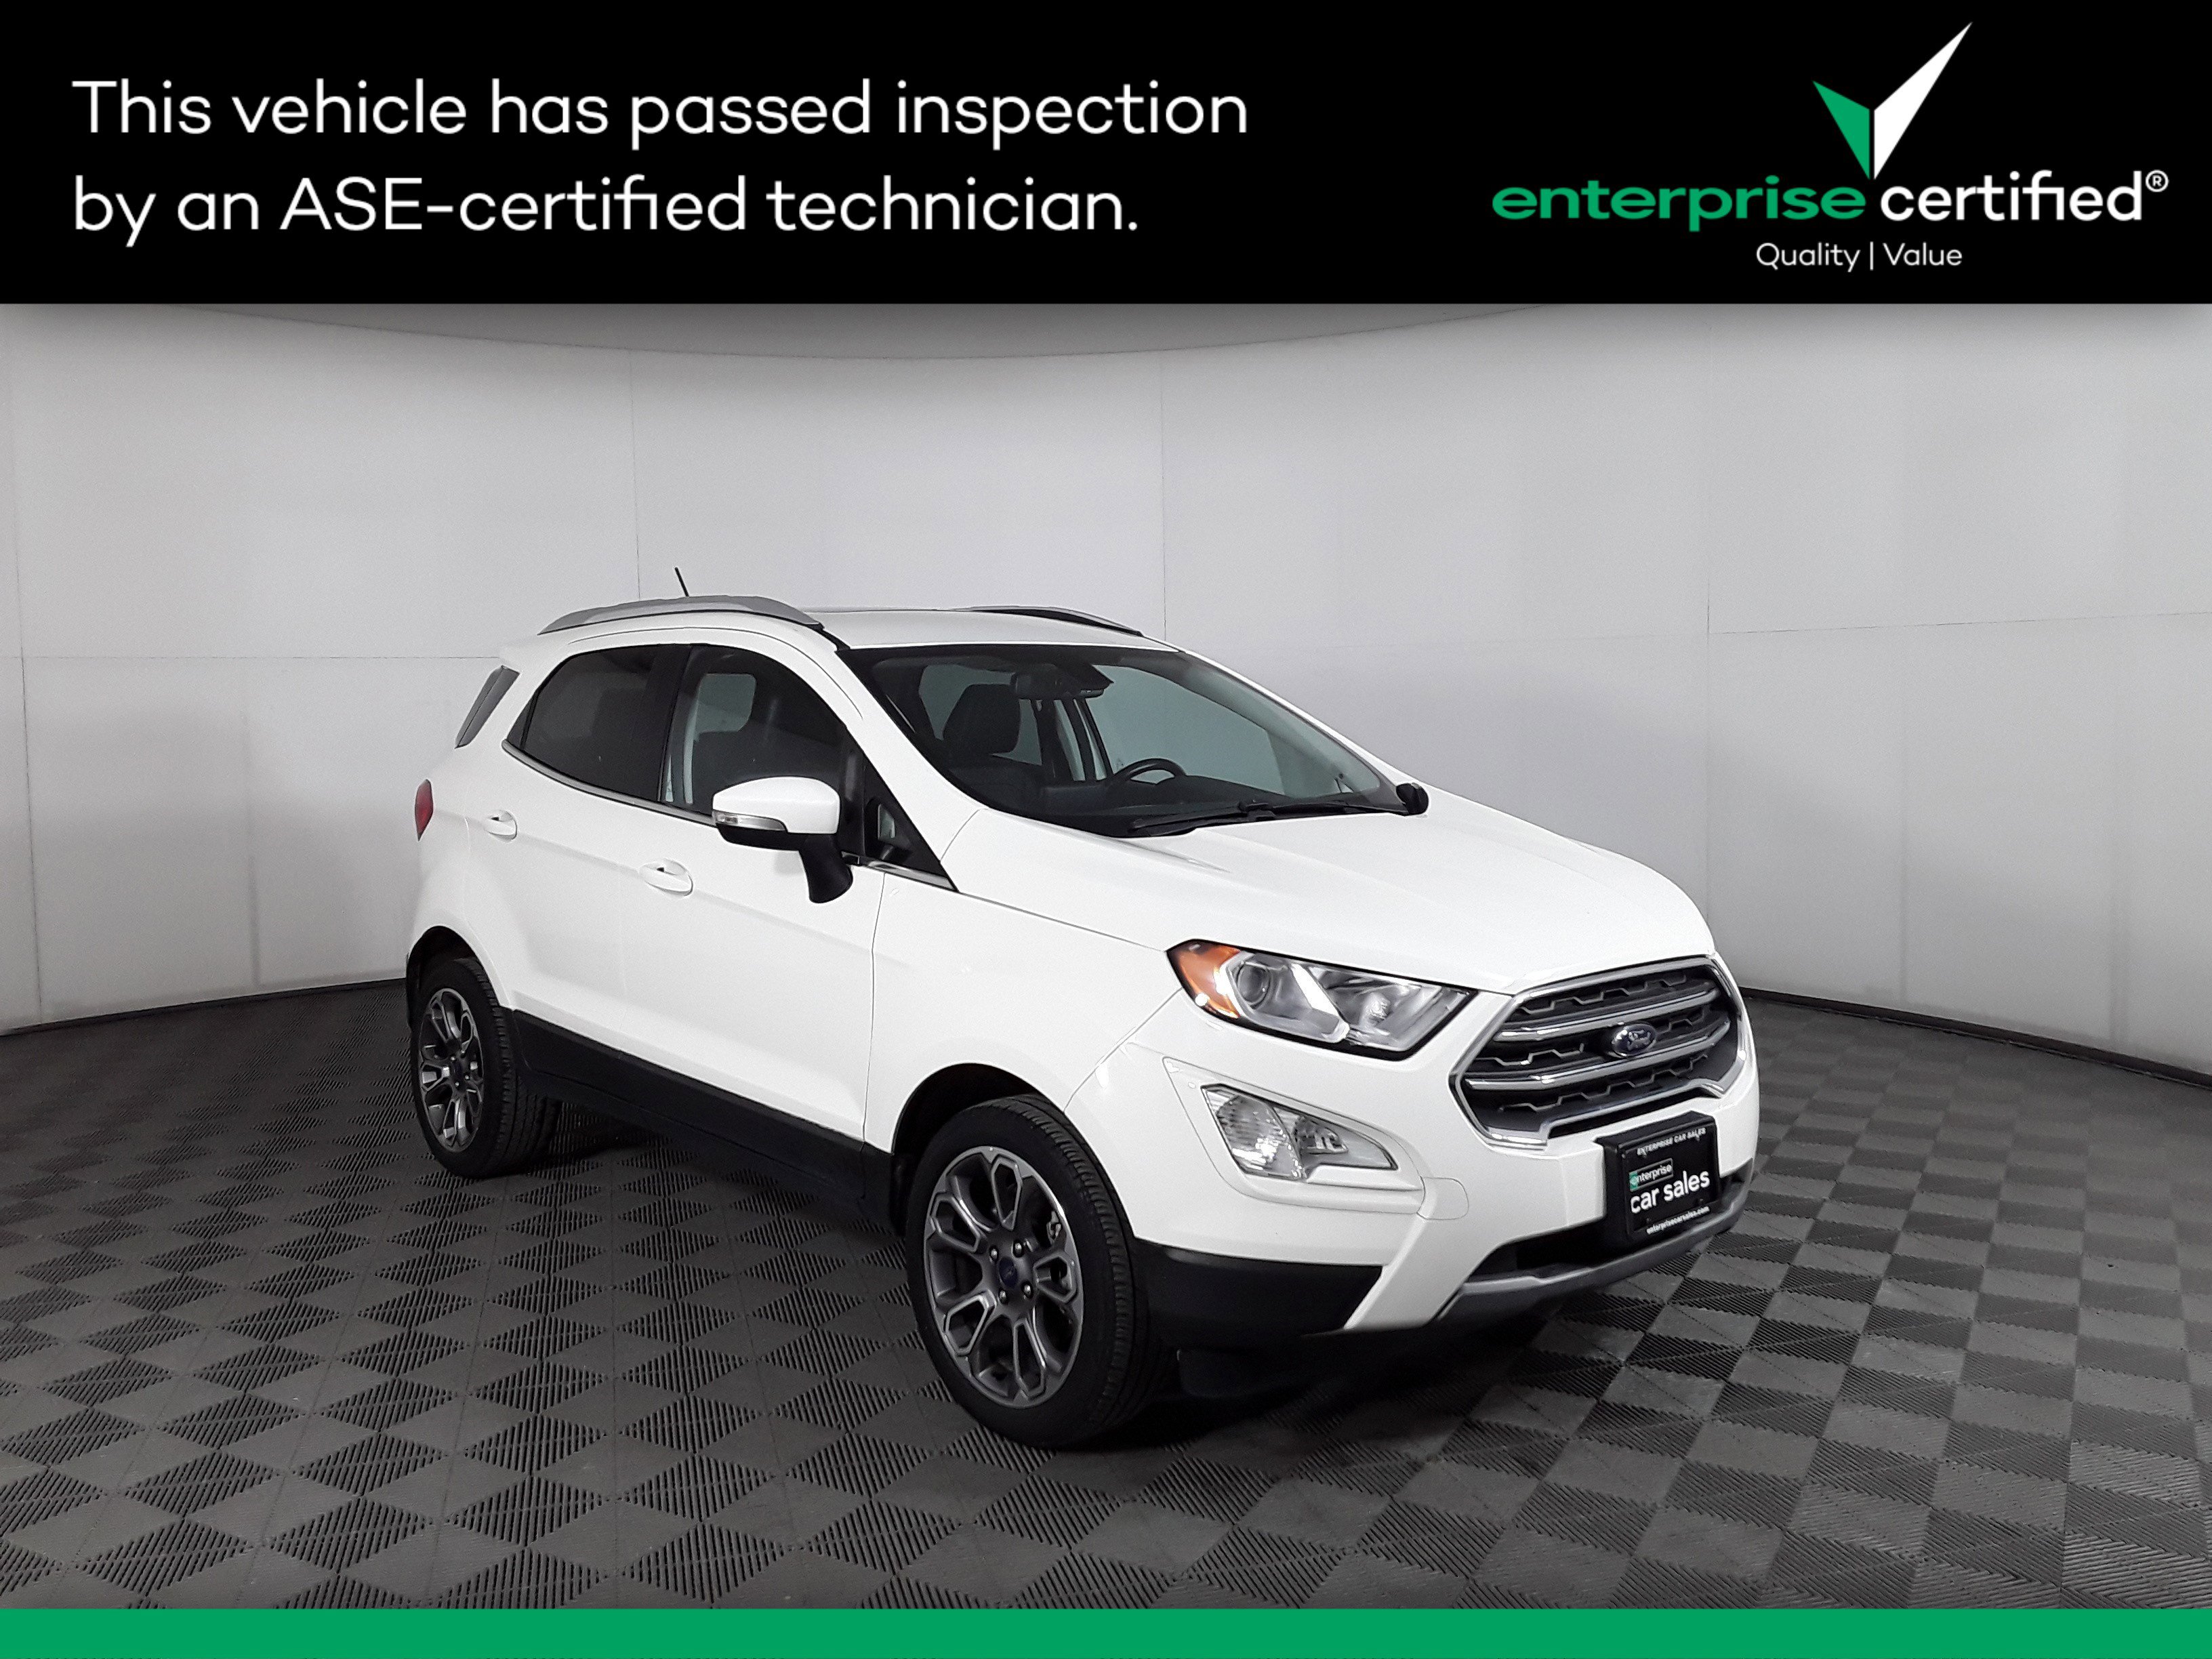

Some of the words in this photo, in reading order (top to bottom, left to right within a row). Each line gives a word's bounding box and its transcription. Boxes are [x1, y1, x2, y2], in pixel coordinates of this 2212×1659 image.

[1629, 1164, 1673, 1186] enterprise
[1631, 1187, 1660, 1214] car
[1663, 1170, 1710, 1202] sales
